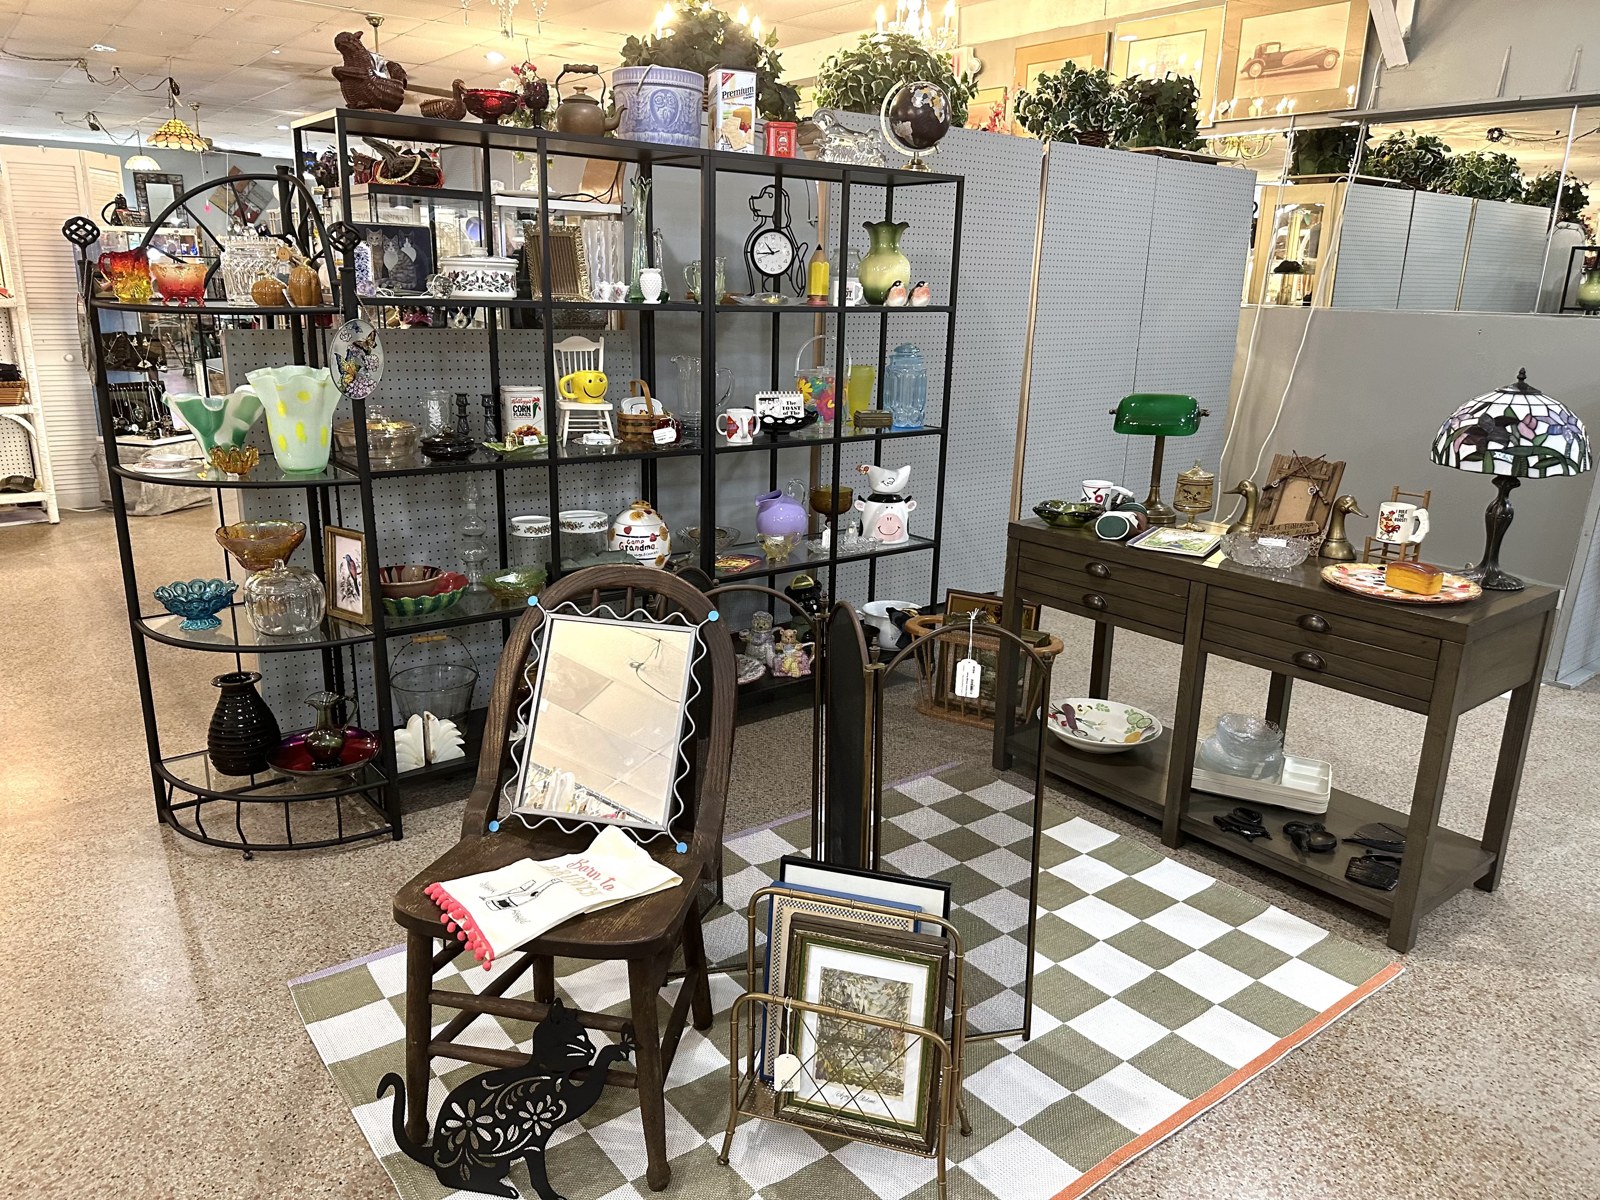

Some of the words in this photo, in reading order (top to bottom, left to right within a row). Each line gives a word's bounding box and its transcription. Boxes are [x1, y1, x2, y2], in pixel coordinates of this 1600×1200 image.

[722, 86, 754, 99] Premium
[512, 405, 532, 413] CORN
[566, 859, 601, 880] Born
